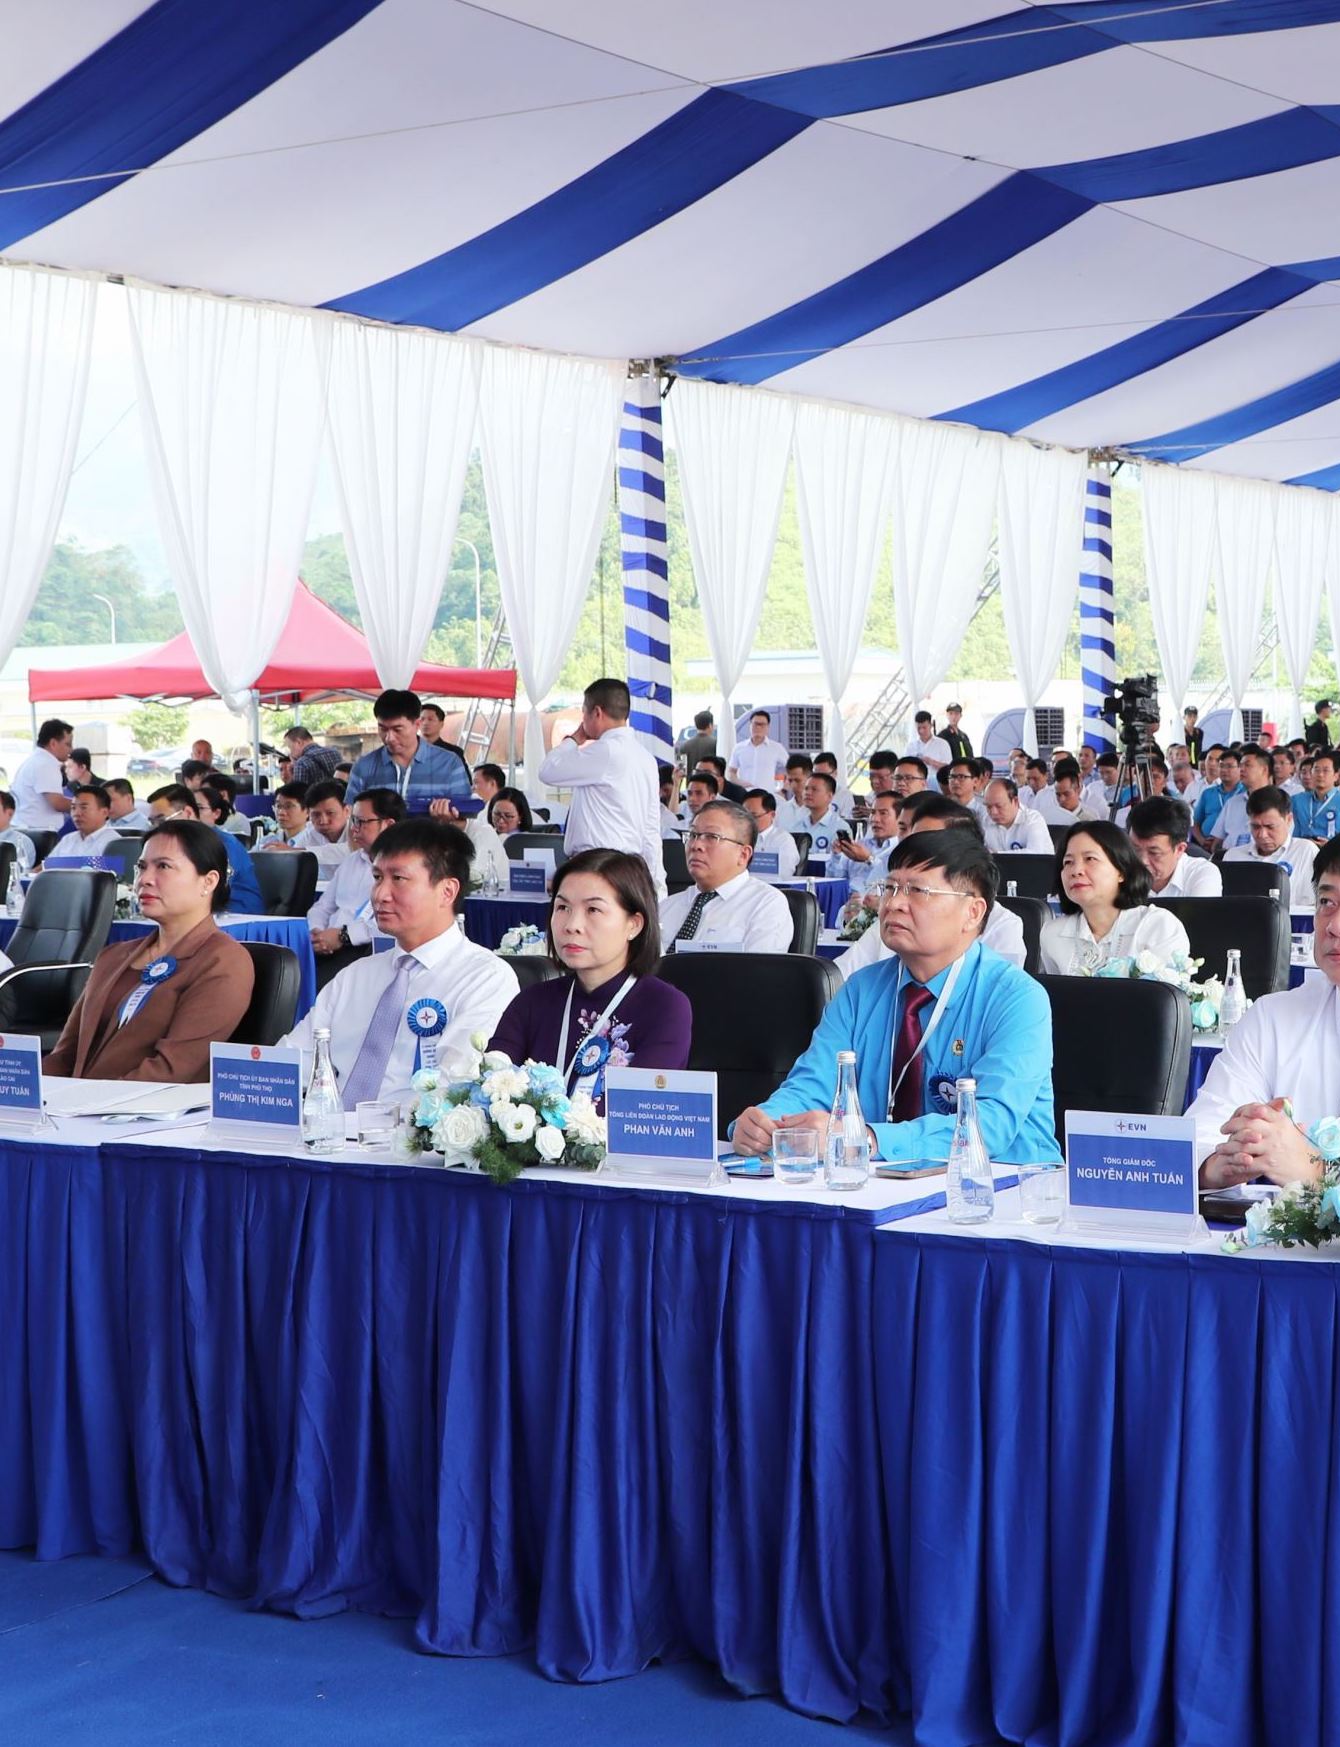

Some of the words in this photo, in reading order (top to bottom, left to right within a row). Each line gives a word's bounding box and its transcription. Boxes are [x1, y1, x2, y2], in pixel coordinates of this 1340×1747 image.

[247, 1095, 259, 1105] THỊ
[261, 1096, 274, 1106] KIM
[276, 1098, 293, 1106] NGA
[624, 1124, 650, 1134] PHAN
[652, 1125, 672, 1136] VĂN
[674, 1128, 694, 1136] ANH
[1123, 1158, 1140, 1166] GIÁM
[1077, 1168, 1122, 1180] NGUYỄN
[1126, 1171, 1149, 1182] ANH
[1152, 1172, 1184, 1184] TUẤN
